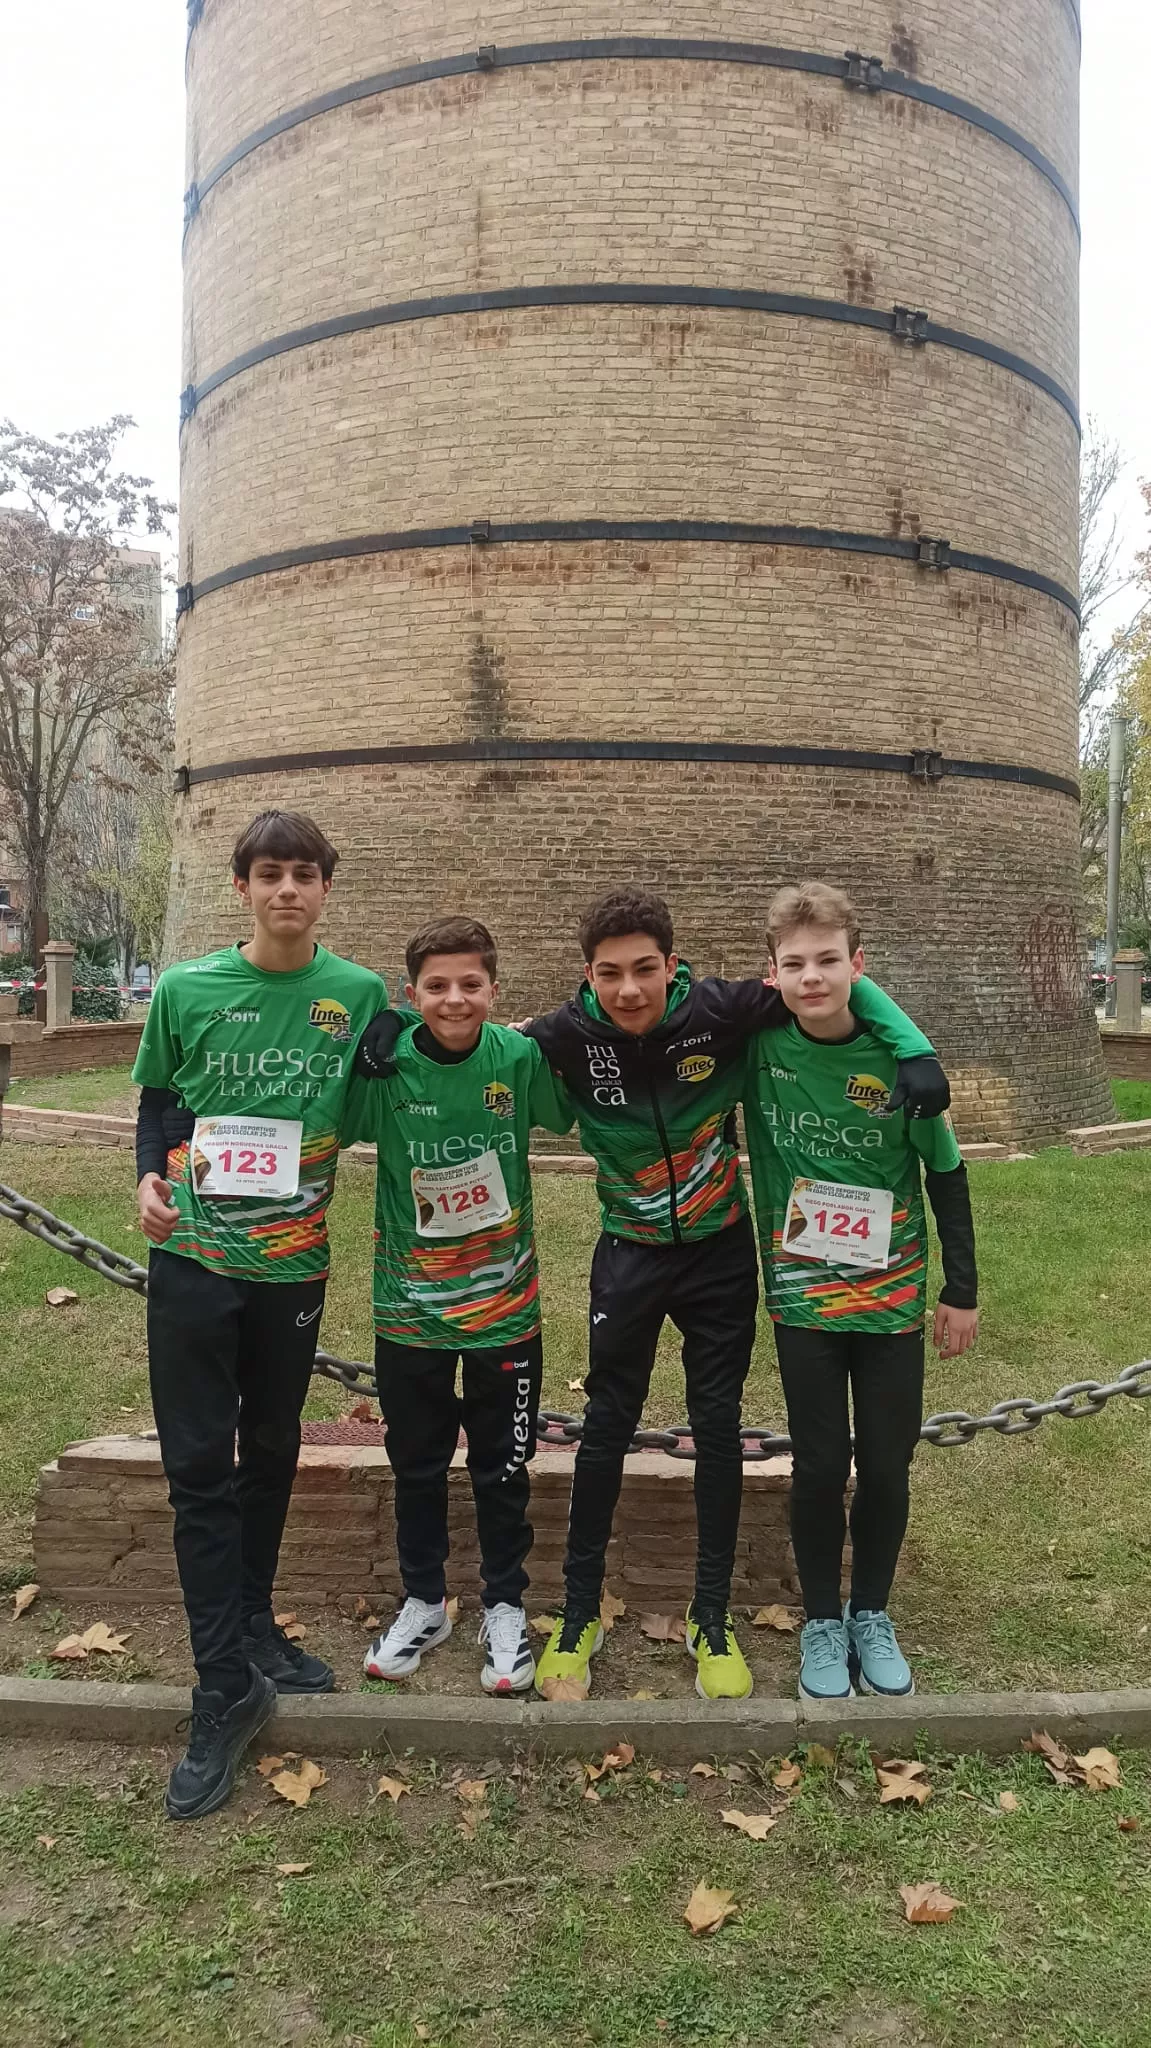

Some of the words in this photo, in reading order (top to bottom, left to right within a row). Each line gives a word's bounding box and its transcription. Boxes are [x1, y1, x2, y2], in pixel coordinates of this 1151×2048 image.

[225, 1011, 260, 1022] ZOITI
[683, 1034, 712, 1047] ZOITI
[408, 1104, 438, 1116] ZOITI
[218, 1149, 278, 1176] 123
[436, 1184, 490, 1214] 128
[814, 1209, 870, 1240] 124
